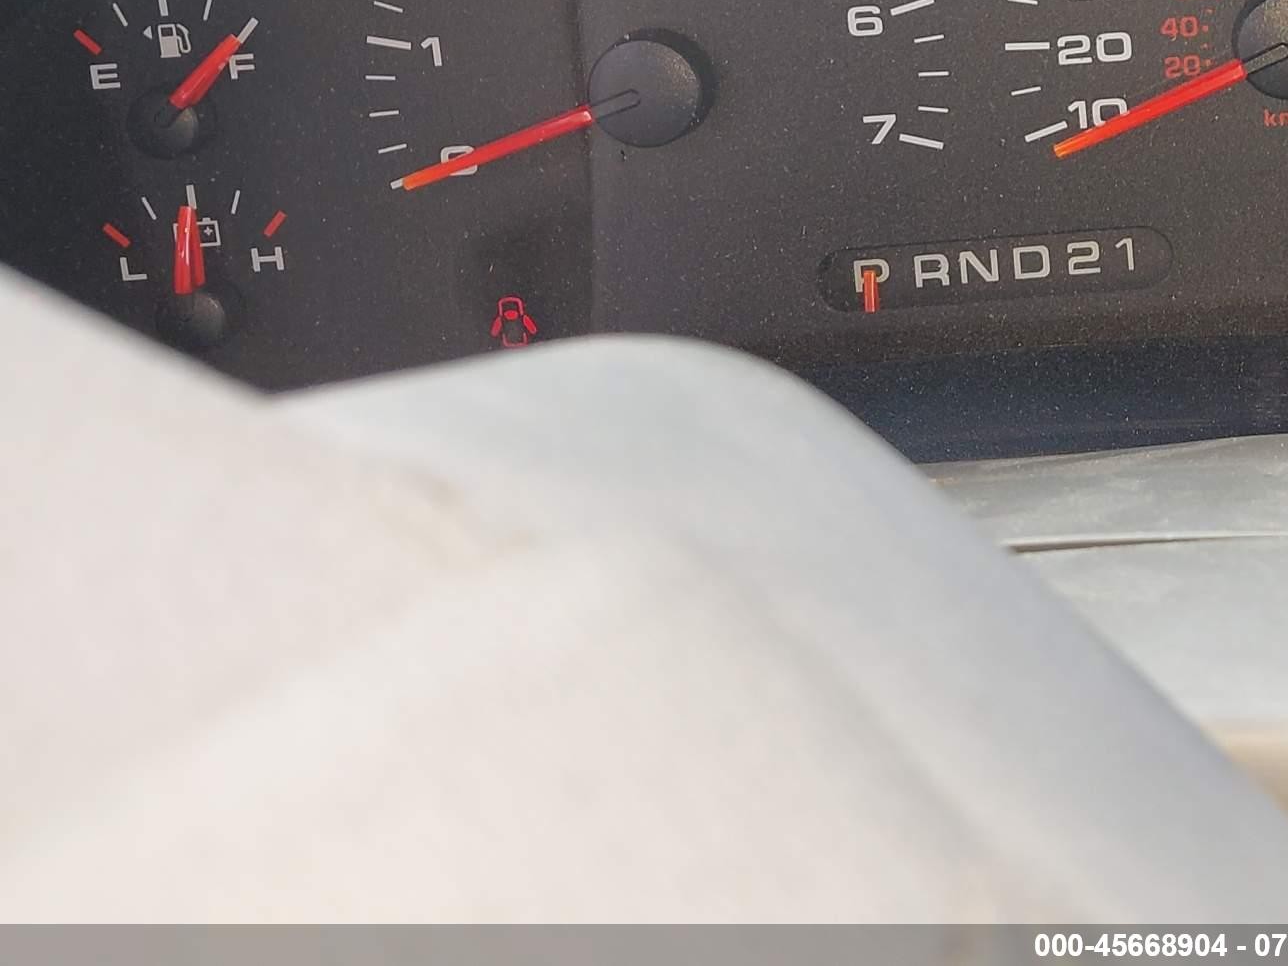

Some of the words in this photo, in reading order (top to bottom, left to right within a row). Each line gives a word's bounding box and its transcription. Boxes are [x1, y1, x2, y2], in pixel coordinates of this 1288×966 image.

[847, 5, 884, 36] 6
[1160, 16, 1199, 37] 40
[421, 36, 443, 67] 1
[1057, 32, 1133, 65] 20
[90, 63, 120, 90] E
[229, 54, 256, 79] F
[1163, 55, 1201, 78] 20
[1067, 97, 1128, 129] 10
[862, 115, 897, 144] 7
[120, 256, 147, 281] L
[251, 246, 285, 271] H
